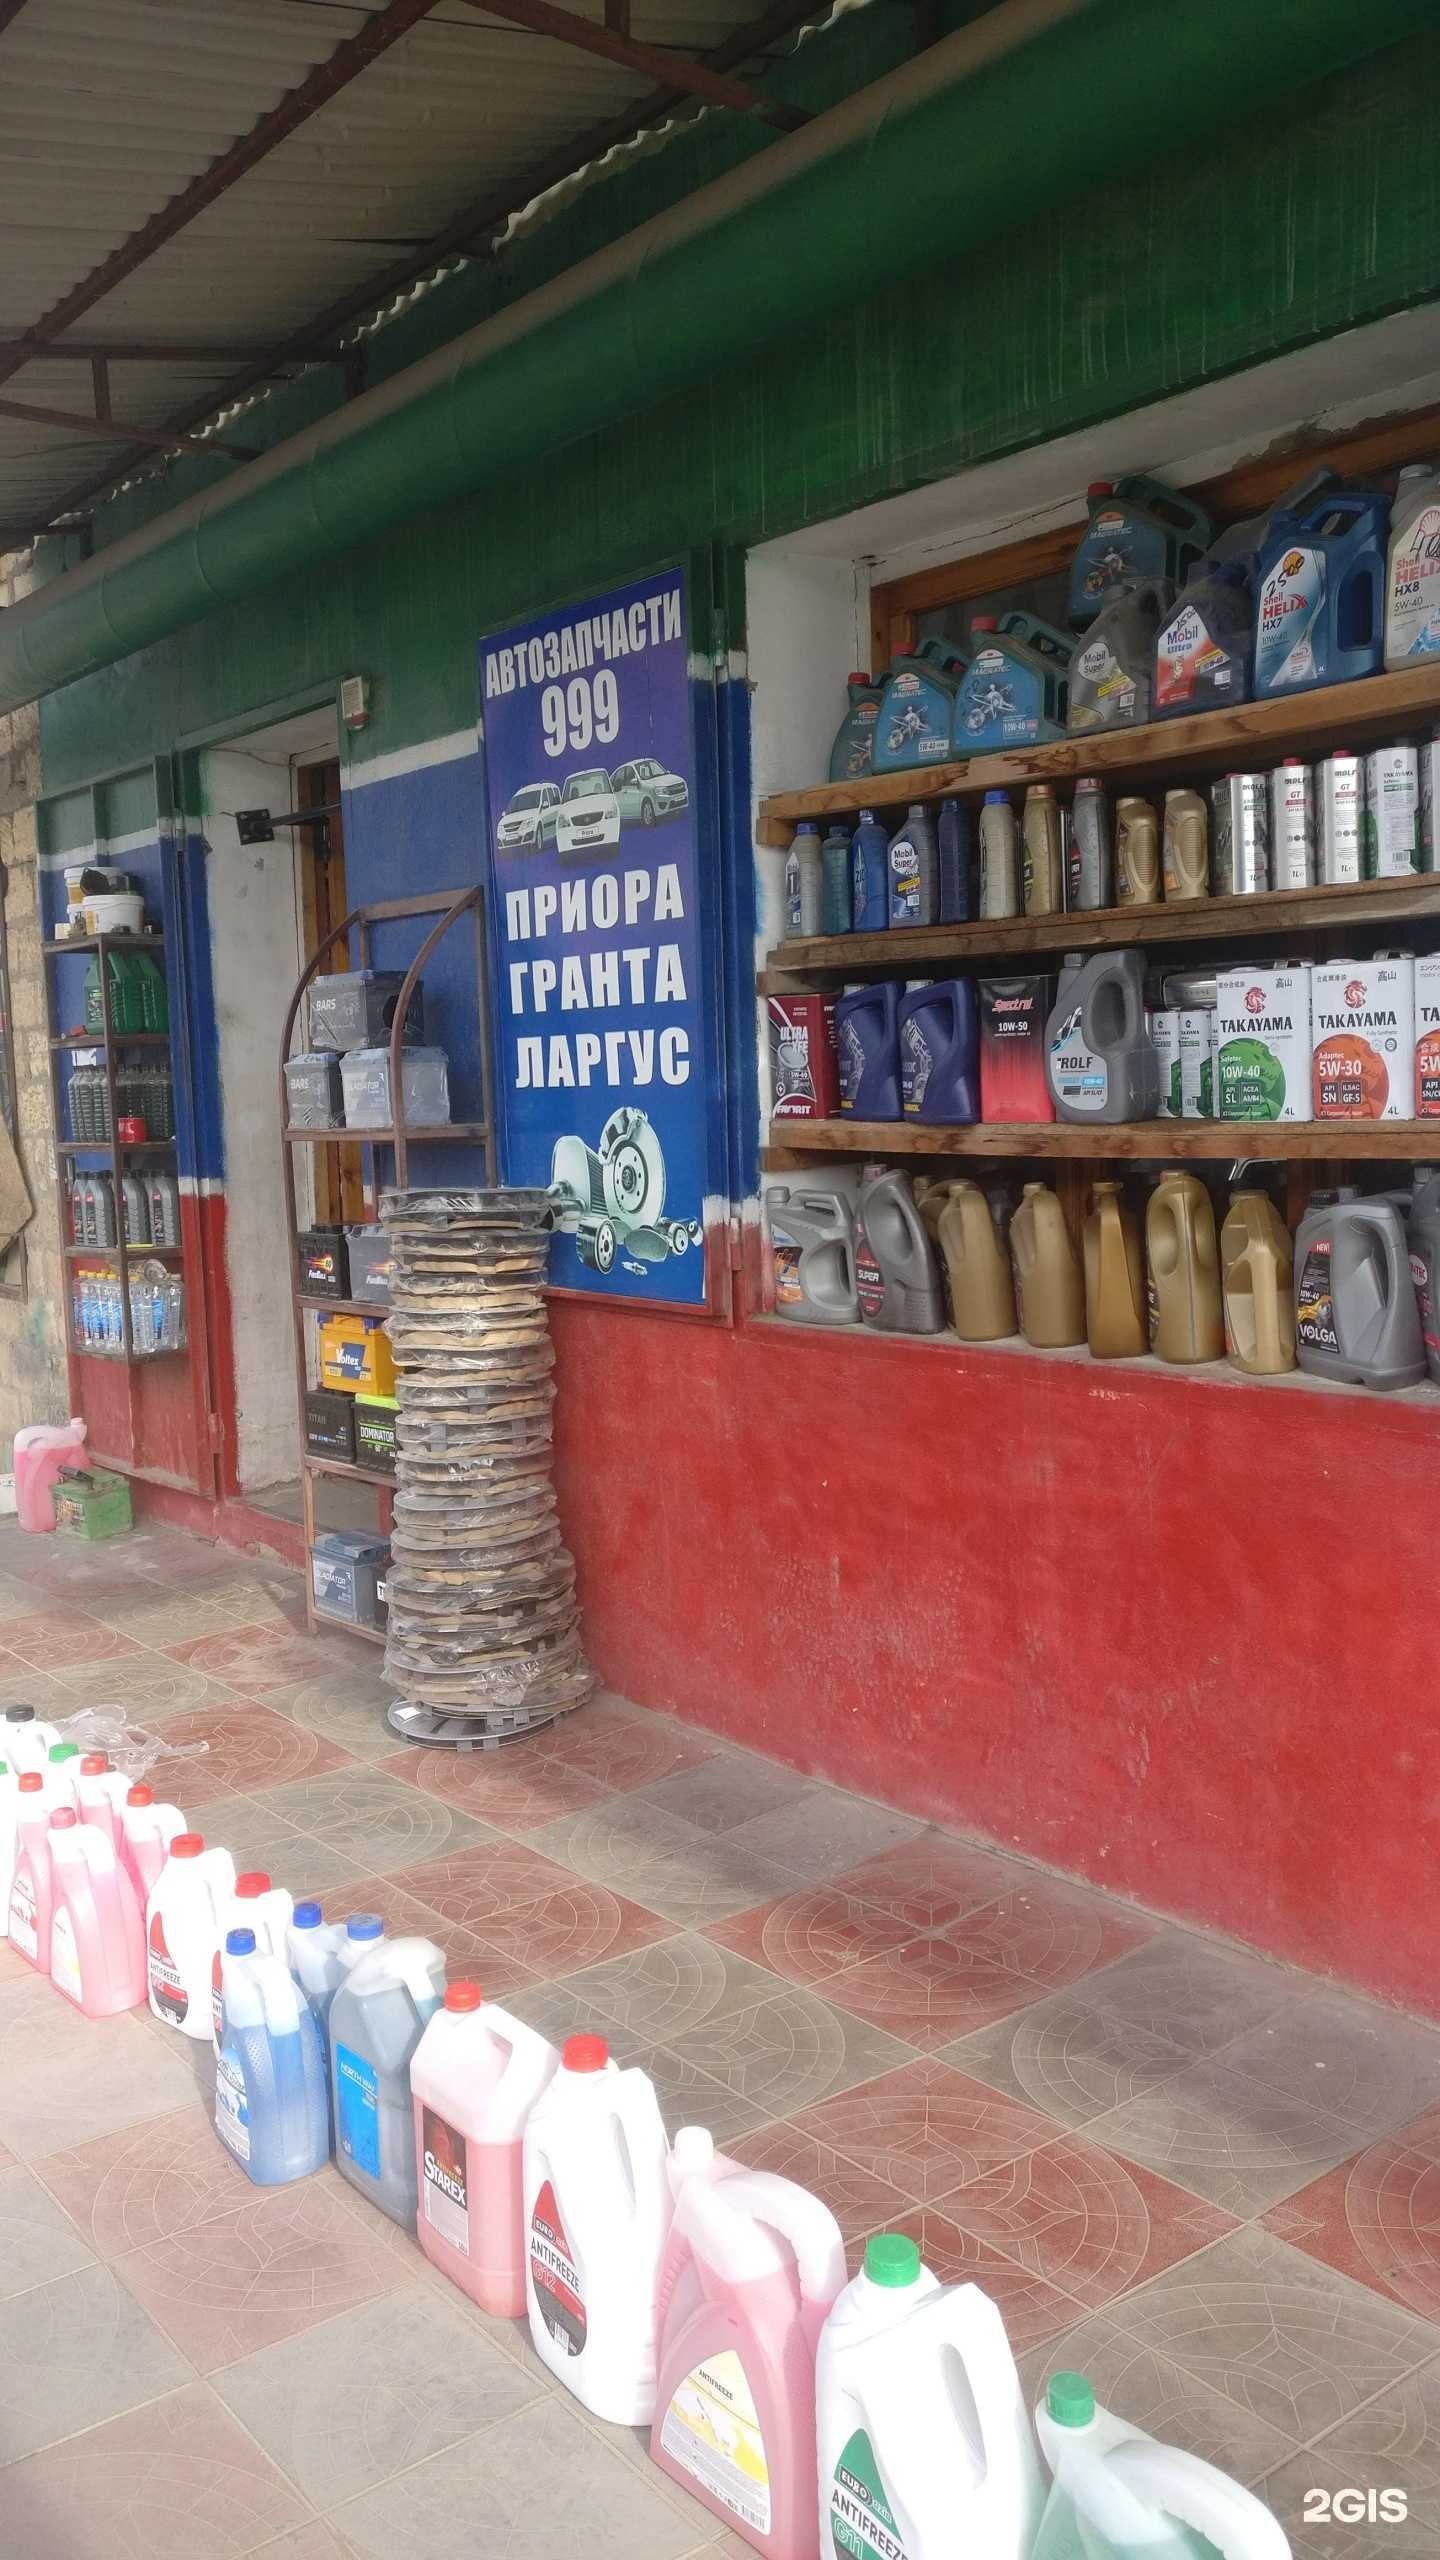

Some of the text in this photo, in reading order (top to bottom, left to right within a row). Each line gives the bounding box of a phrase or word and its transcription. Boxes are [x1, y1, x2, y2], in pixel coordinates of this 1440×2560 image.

[1394, 581, 1420, 598] HX8
[1262, 593, 1308, 621] HELIX
[1262, 618, 1282, 632] HX7
[486, 589, 682, 698] АВТОЗАПЧАСТИ
[1167, 625, 1199, 646] Mobil
[1084, 650, 1106, 663] Mobil
[1084, 663, 1106, 674] Super
[541, 669, 619, 757] 999
[894, 848, 914, 858] Mobil
[894, 859, 913, 868] Super
[505, 863, 685, 941] ПРИОРА
[509, 943, 687, 1015] ГРАНТА
[315, 998, 336, 1011] BARS
[998, 1021, 1028, 1032] 10W-50
[1220, 1016, 1293, 1033] TAKAYAMA
[1318, 1011, 1397, 1029] TAKAYAMA
[780, 1026, 808, 1041] ULTRA
[515, 1026, 690, 1089] ЛАРГУС
[1059, 1056, 1094, 1069] ROLF
[1222, 1065, 1260, 1079] 10W-40
[1319, 1060, 1362, 1077] 5W-30
[1225, 1094, 1237, 1104] SL
[1322, 1092, 1337, 1103] SN
[1342, 1092, 1360, 1103] GF-5
[776, 1104, 812, 1114] FAVORIT
[1285, 1106, 1295, 1116] 4L
[1388, 1106, 1399, 1115] 4L
[858, 1269, 879, 1282] SUPER
[1299, 1324, 1338, 1345] VOLGA
[335, 1347, 359, 1366] Voltex
[360, 1426, 395, 1443] DOMINATOR
[424, 2150, 465, 2206] STAREX
[530, 2236, 580, 2293] ANTIFREEZE
[698, 2369, 734, 2401] ANTIFREEZE
[840, 2469, 868, 2499] EURO
